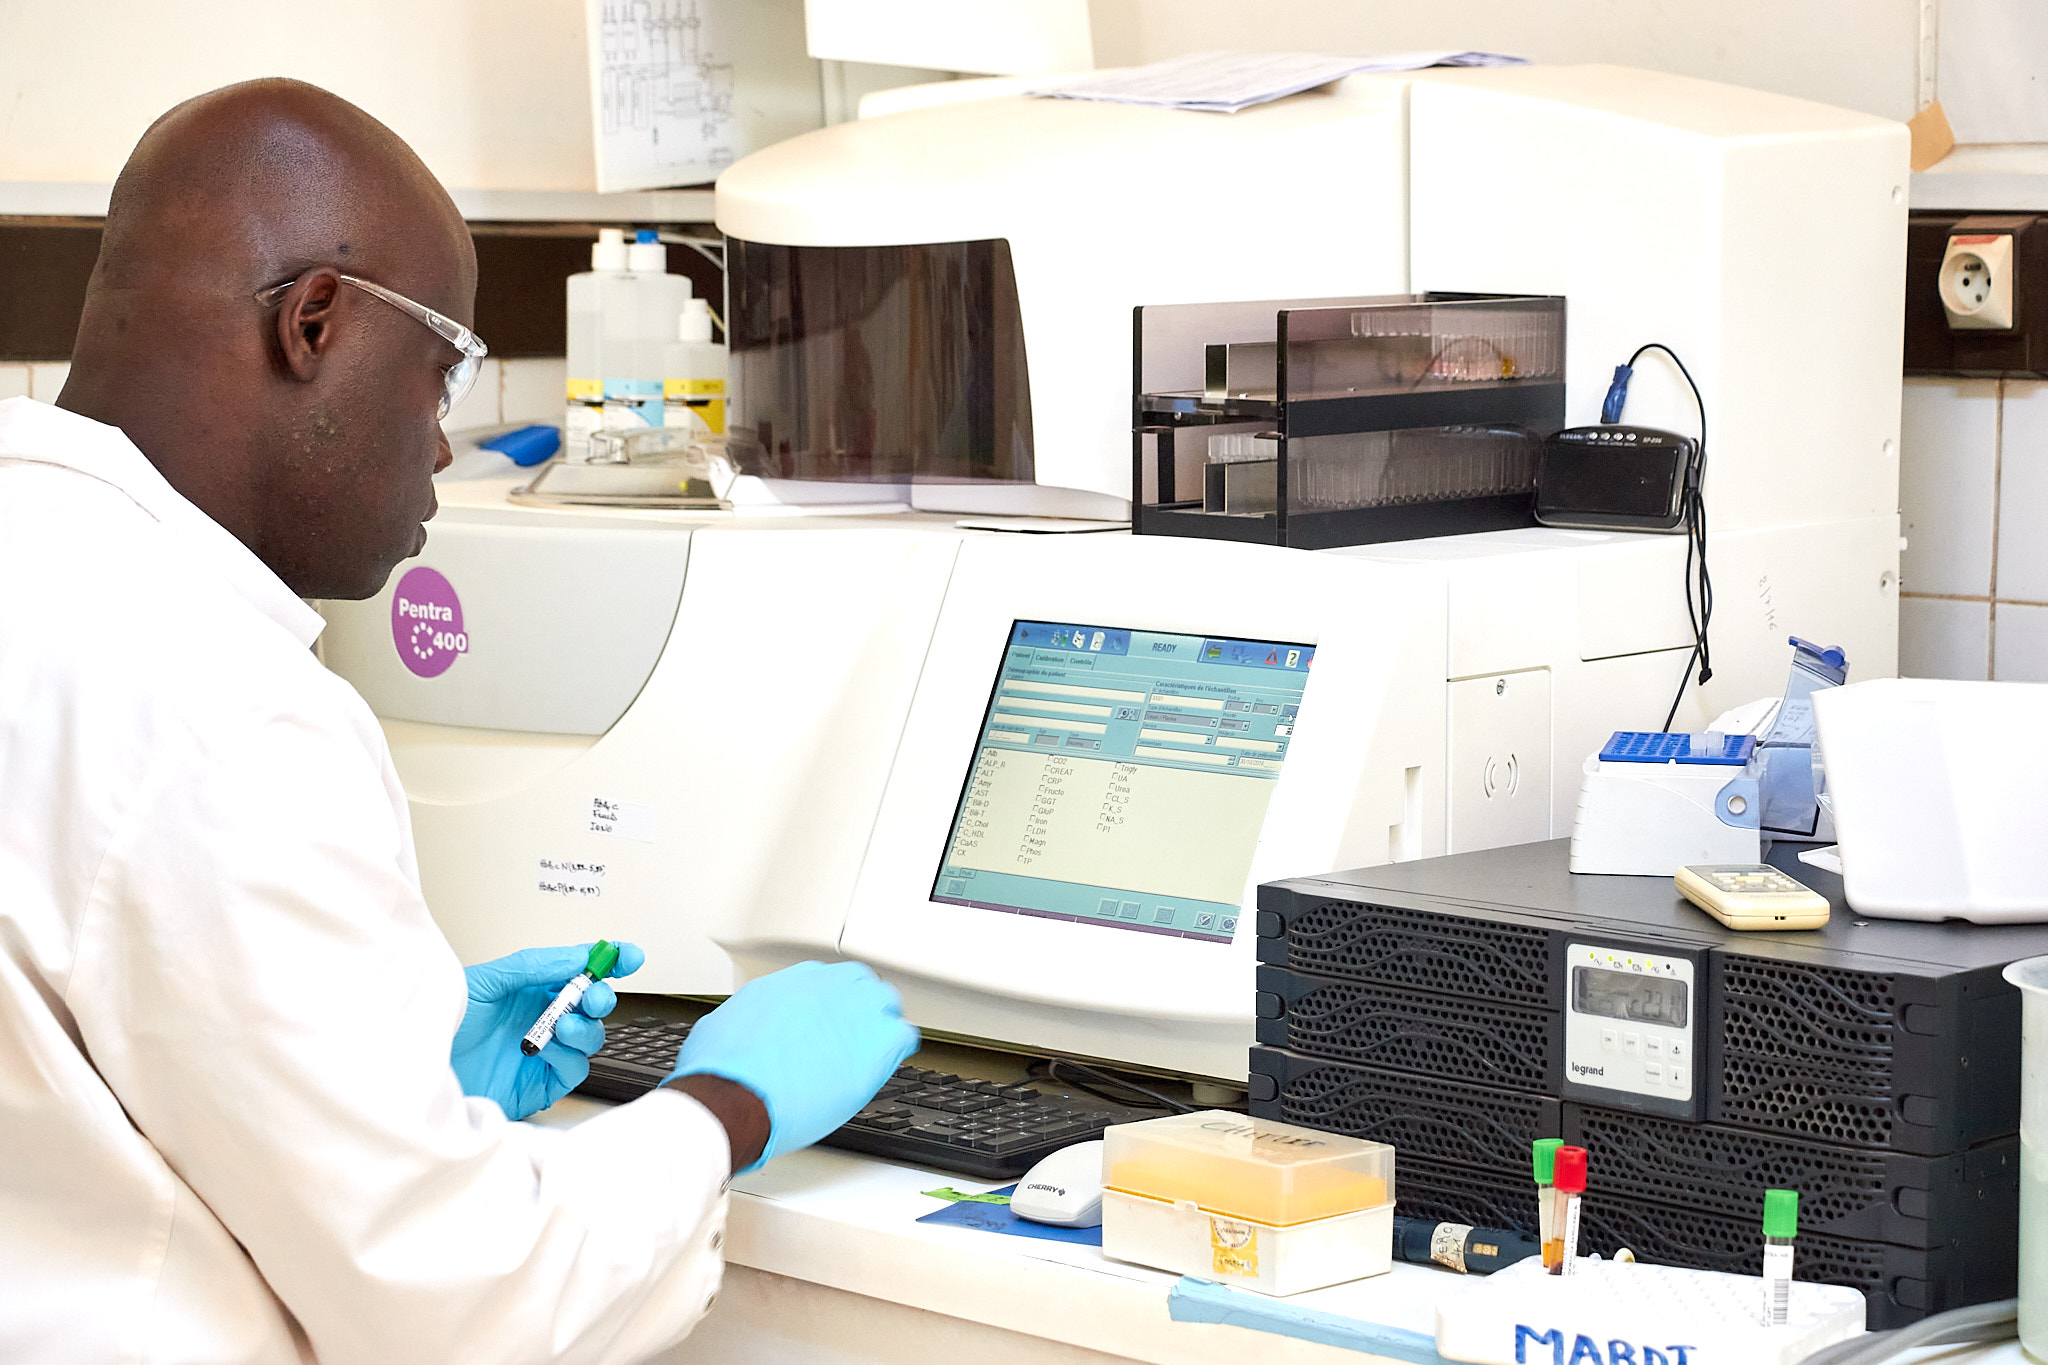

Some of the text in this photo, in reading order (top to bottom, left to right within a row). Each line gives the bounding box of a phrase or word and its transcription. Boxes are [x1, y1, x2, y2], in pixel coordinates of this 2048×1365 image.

[399, 597, 453, 622] Pentra
[433, 632, 467, 652] 400
[1152, 643, 1177, 653] READY
[1036, 655, 1064, 663] Calibration
[1070, 658, 1092, 666] Contrôle
[1048, 670, 1066, 678] patient
[1156, 681, 1197, 691] Caractéristiques
[984, 760, 1006, 768] ALP_R
[1053, 756, 1068, 765] CO2
[1050, 767, 1073, 776] CREAT
[1121, 764, 1138, 774] Trigly
[1047, 776, 1062, 785] CRP
[1118, 774, 1128, 782] UA
[978, 780, 992, 788] Amy
[1044, 787, 1064, 796] Fructo
[1114, 784, 1130, 794] Urea
[1041, 797, 1056, 806] GGT
[1035, 817, 1048, 826] Iron
[1106, 815, 1124, 824] NA_S
[1032, 827, 1046, 836] LDH
[1030, 837, 1046, 847] Magn
[1026, 848, 1042, 856] Phos
[1023, 857, 1032, 865] TP
[1572, 1062, 1604, 1076] legrand
[1027, 1183, 1058, 1194] CHERRY
